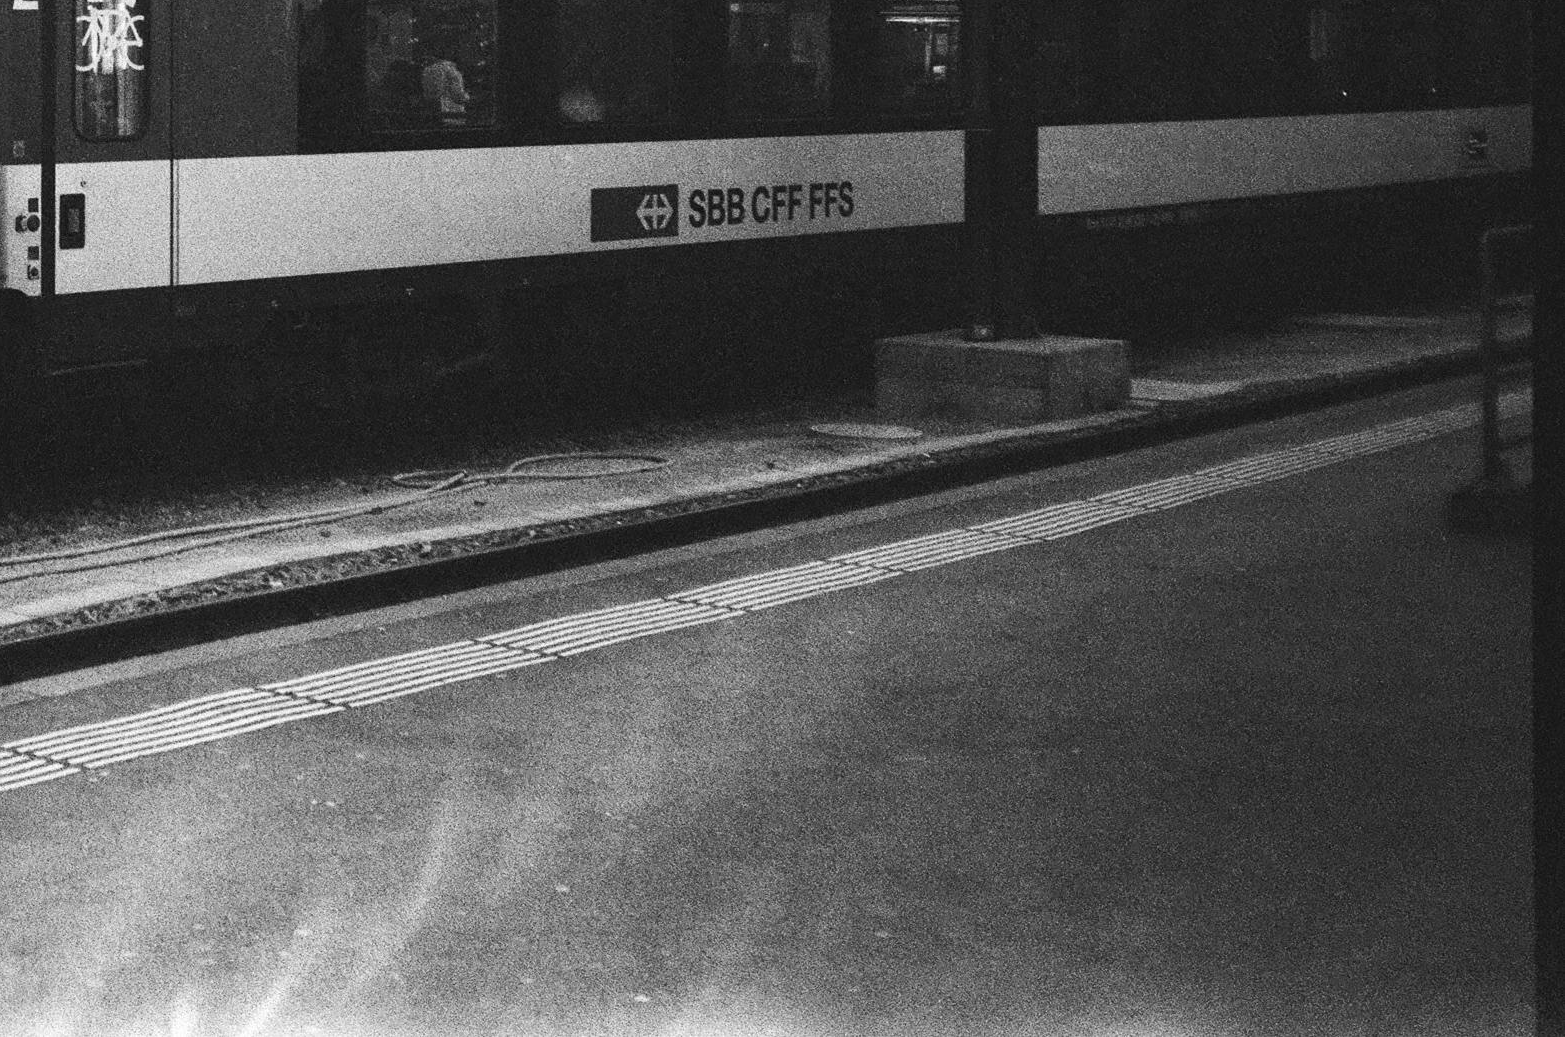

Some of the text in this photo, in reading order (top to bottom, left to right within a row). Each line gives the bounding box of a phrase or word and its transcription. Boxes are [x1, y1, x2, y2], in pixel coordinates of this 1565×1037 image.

[688, 180, 854, 228] SBB CFF FFS
